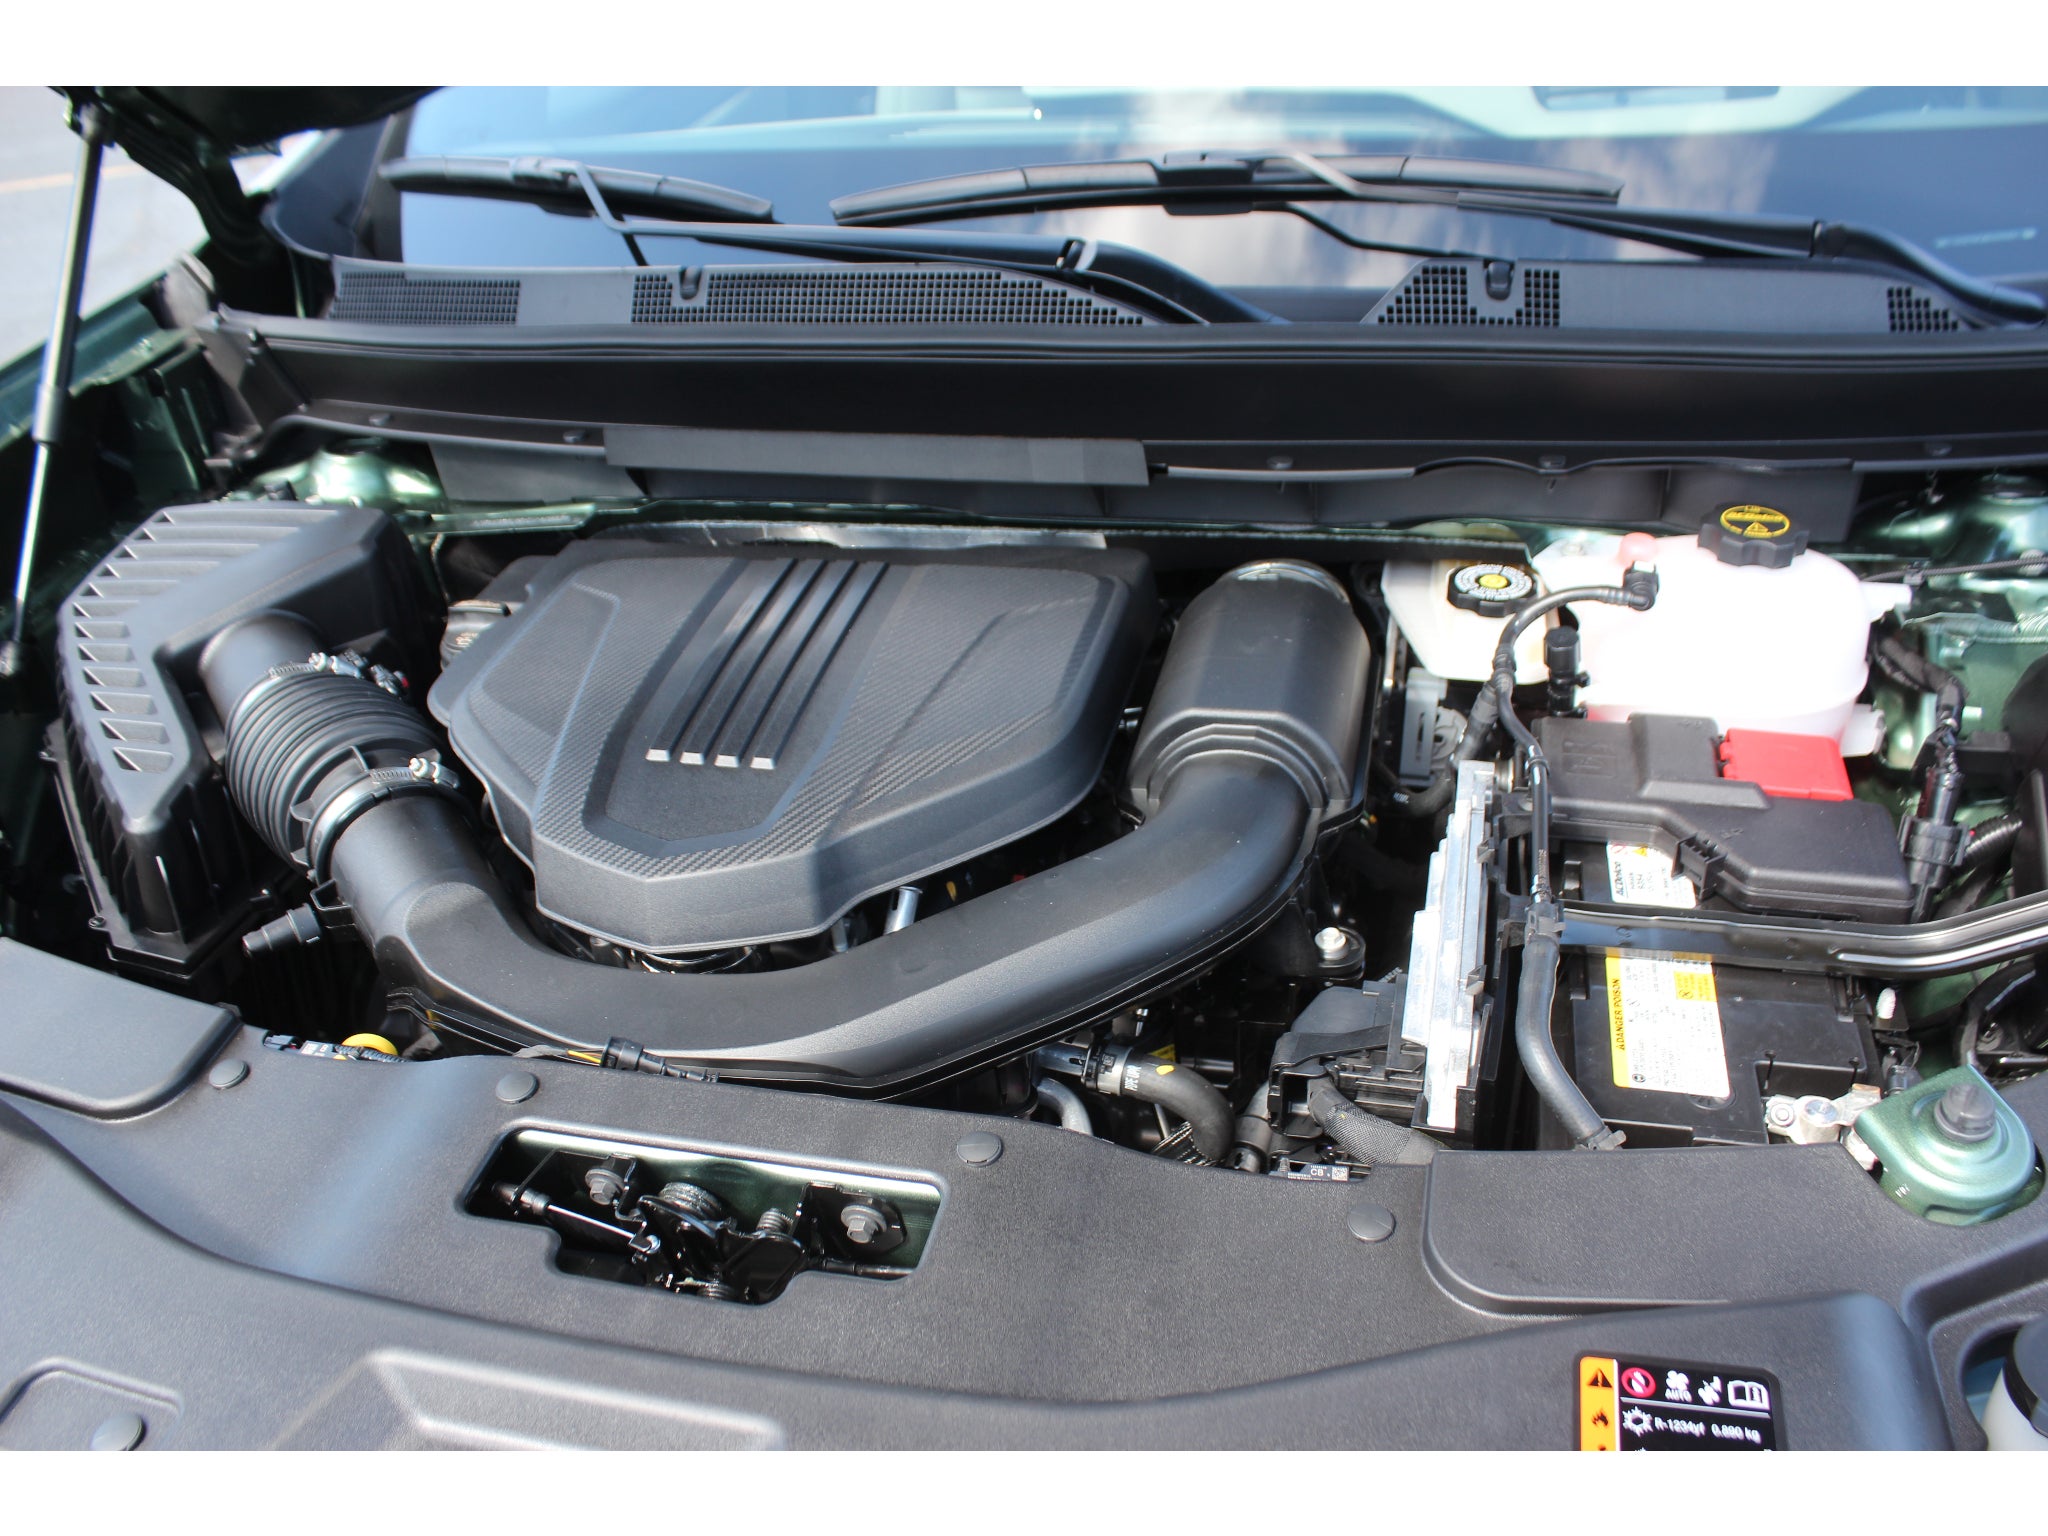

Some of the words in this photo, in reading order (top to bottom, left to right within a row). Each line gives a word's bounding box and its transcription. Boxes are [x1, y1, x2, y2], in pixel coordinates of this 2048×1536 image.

[1612, 979, 1622, 1008] POISON
[1614, 1010, 1625, 1043] DANGER
[1665, 1388, 1693, 1403] AUTO
[1744, 1427, 1762, 1445] kg
